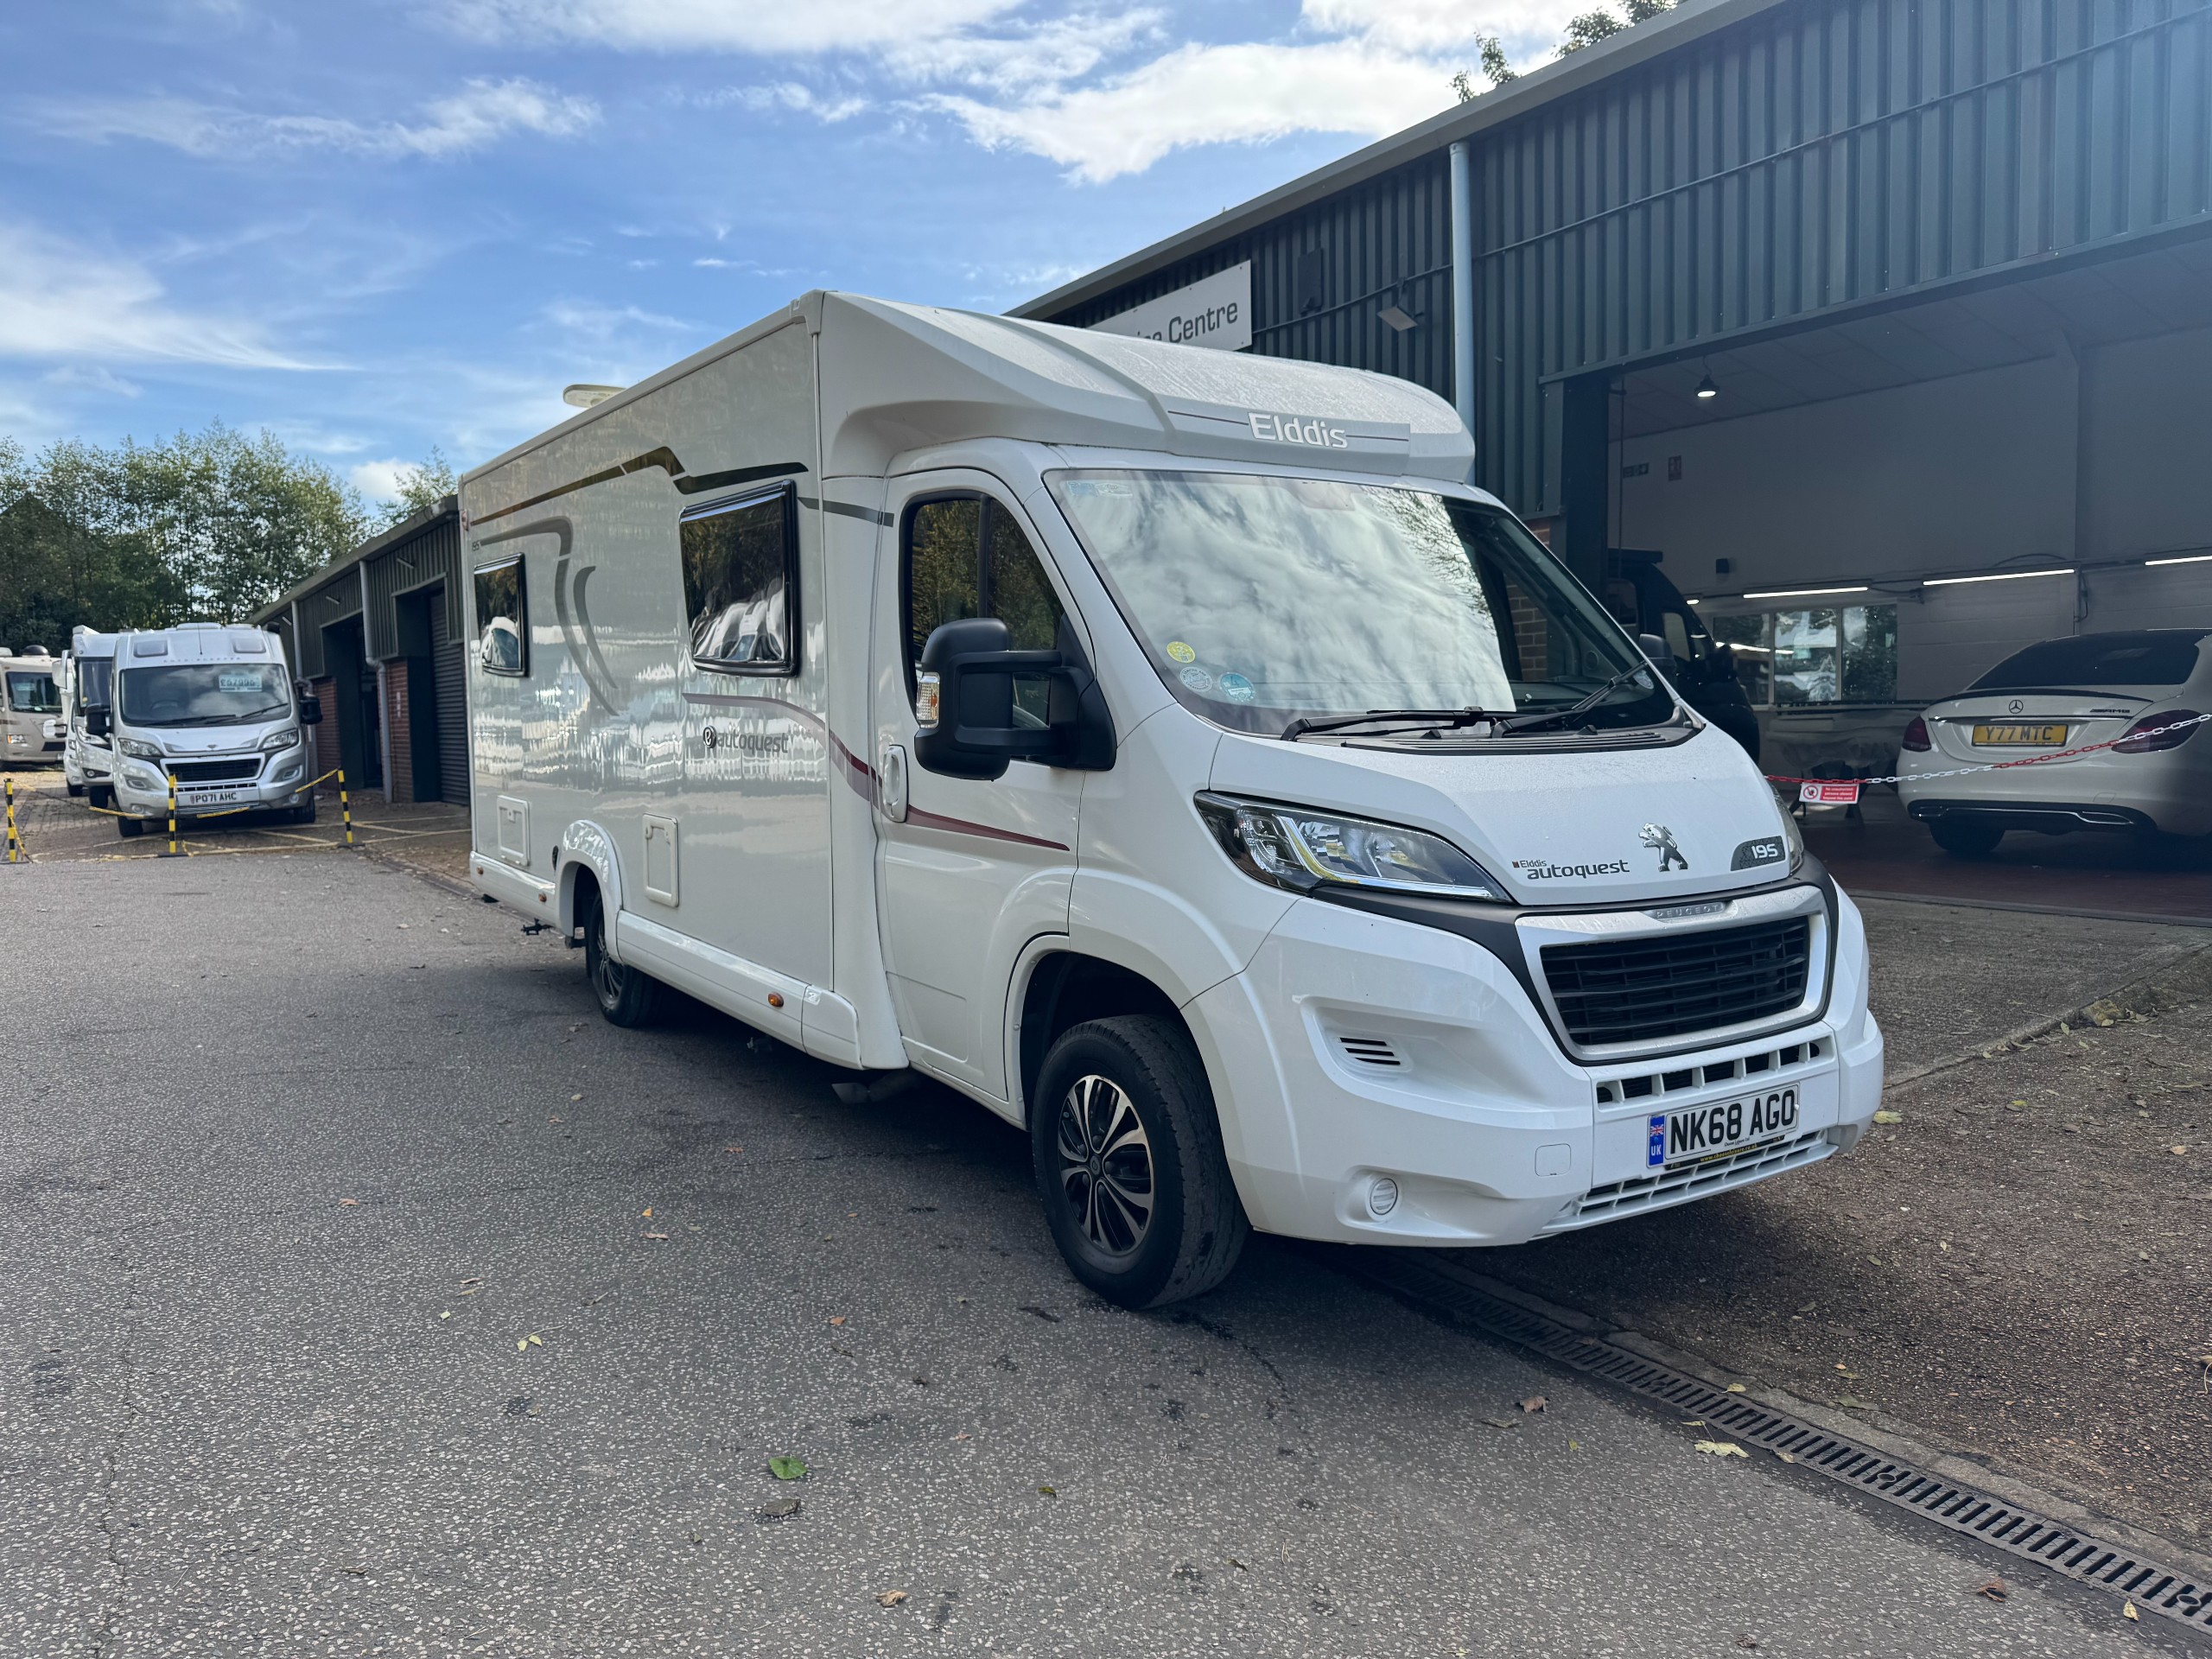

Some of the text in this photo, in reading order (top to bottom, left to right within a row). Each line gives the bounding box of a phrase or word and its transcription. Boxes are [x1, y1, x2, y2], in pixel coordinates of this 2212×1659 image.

[1168, 302, 1238, 344] Centre
[1248, 411, 1348, 448] Elddis
[717, 729, 789, 755] autoquest
[1986, 727, 2053, 741] Y77 MTC
[195, 792, 237, 803] PO71 AHC
[1751, 843, 1778, 860] 195
[1520, 859, 1548, 868] Elddis
[1527, 859, 1630, 880] autoquest
[1656, 905, 1719, 918] PEUGEOT
[1670, 1090, 1795, 1154] NK68 AGO
[1650, 1145, 1662, 1156] UK
